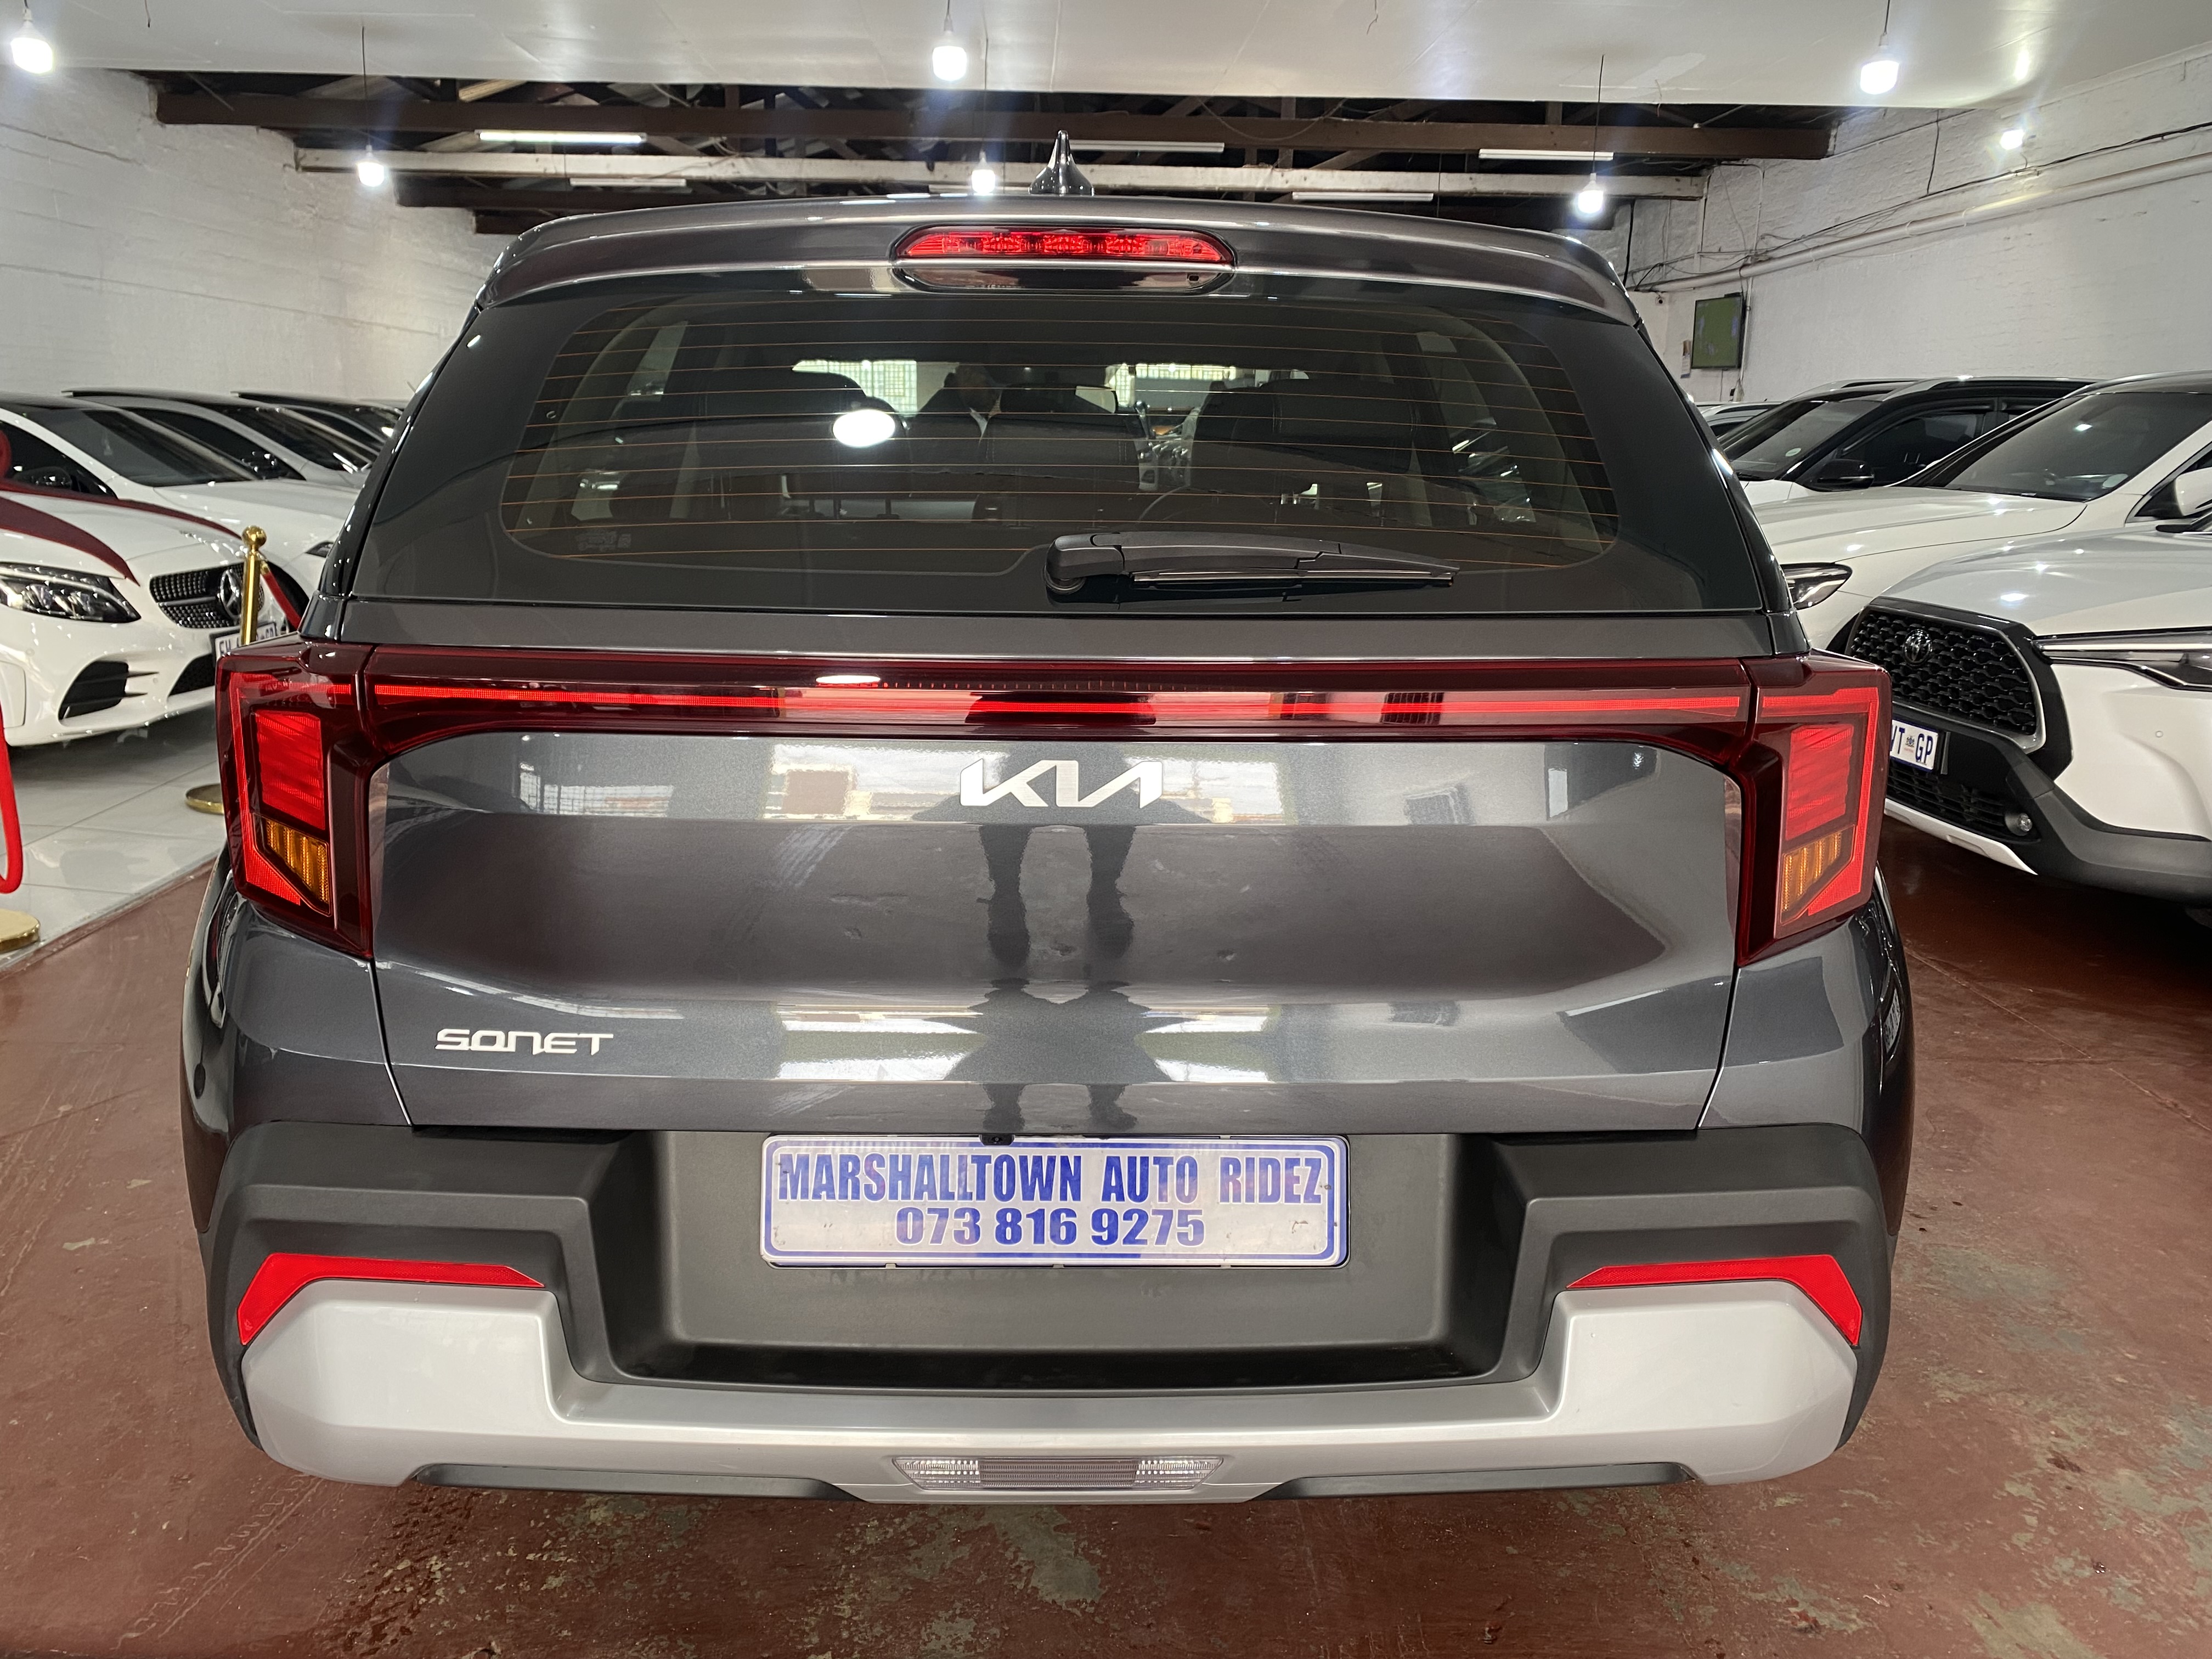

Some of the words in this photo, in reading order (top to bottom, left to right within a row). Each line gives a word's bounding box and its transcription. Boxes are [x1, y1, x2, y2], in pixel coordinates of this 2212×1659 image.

[1915, 733, 1934, 764] GP
[960, 758, 1163, 809] KIA
[435, 1029, 614, 1056] SONET
[778, 1153, 1082, 1203] MARSHALLTOWN
[1101, 1156, 1199, 1204] AUTO
[1220, 1157, 1324, 1205] RIDEZ
[896, 1207, 981, 1246] 073
[994, 1207, 1078, 1246] 816
[1090, 1207, 1206, 1247] 9275
